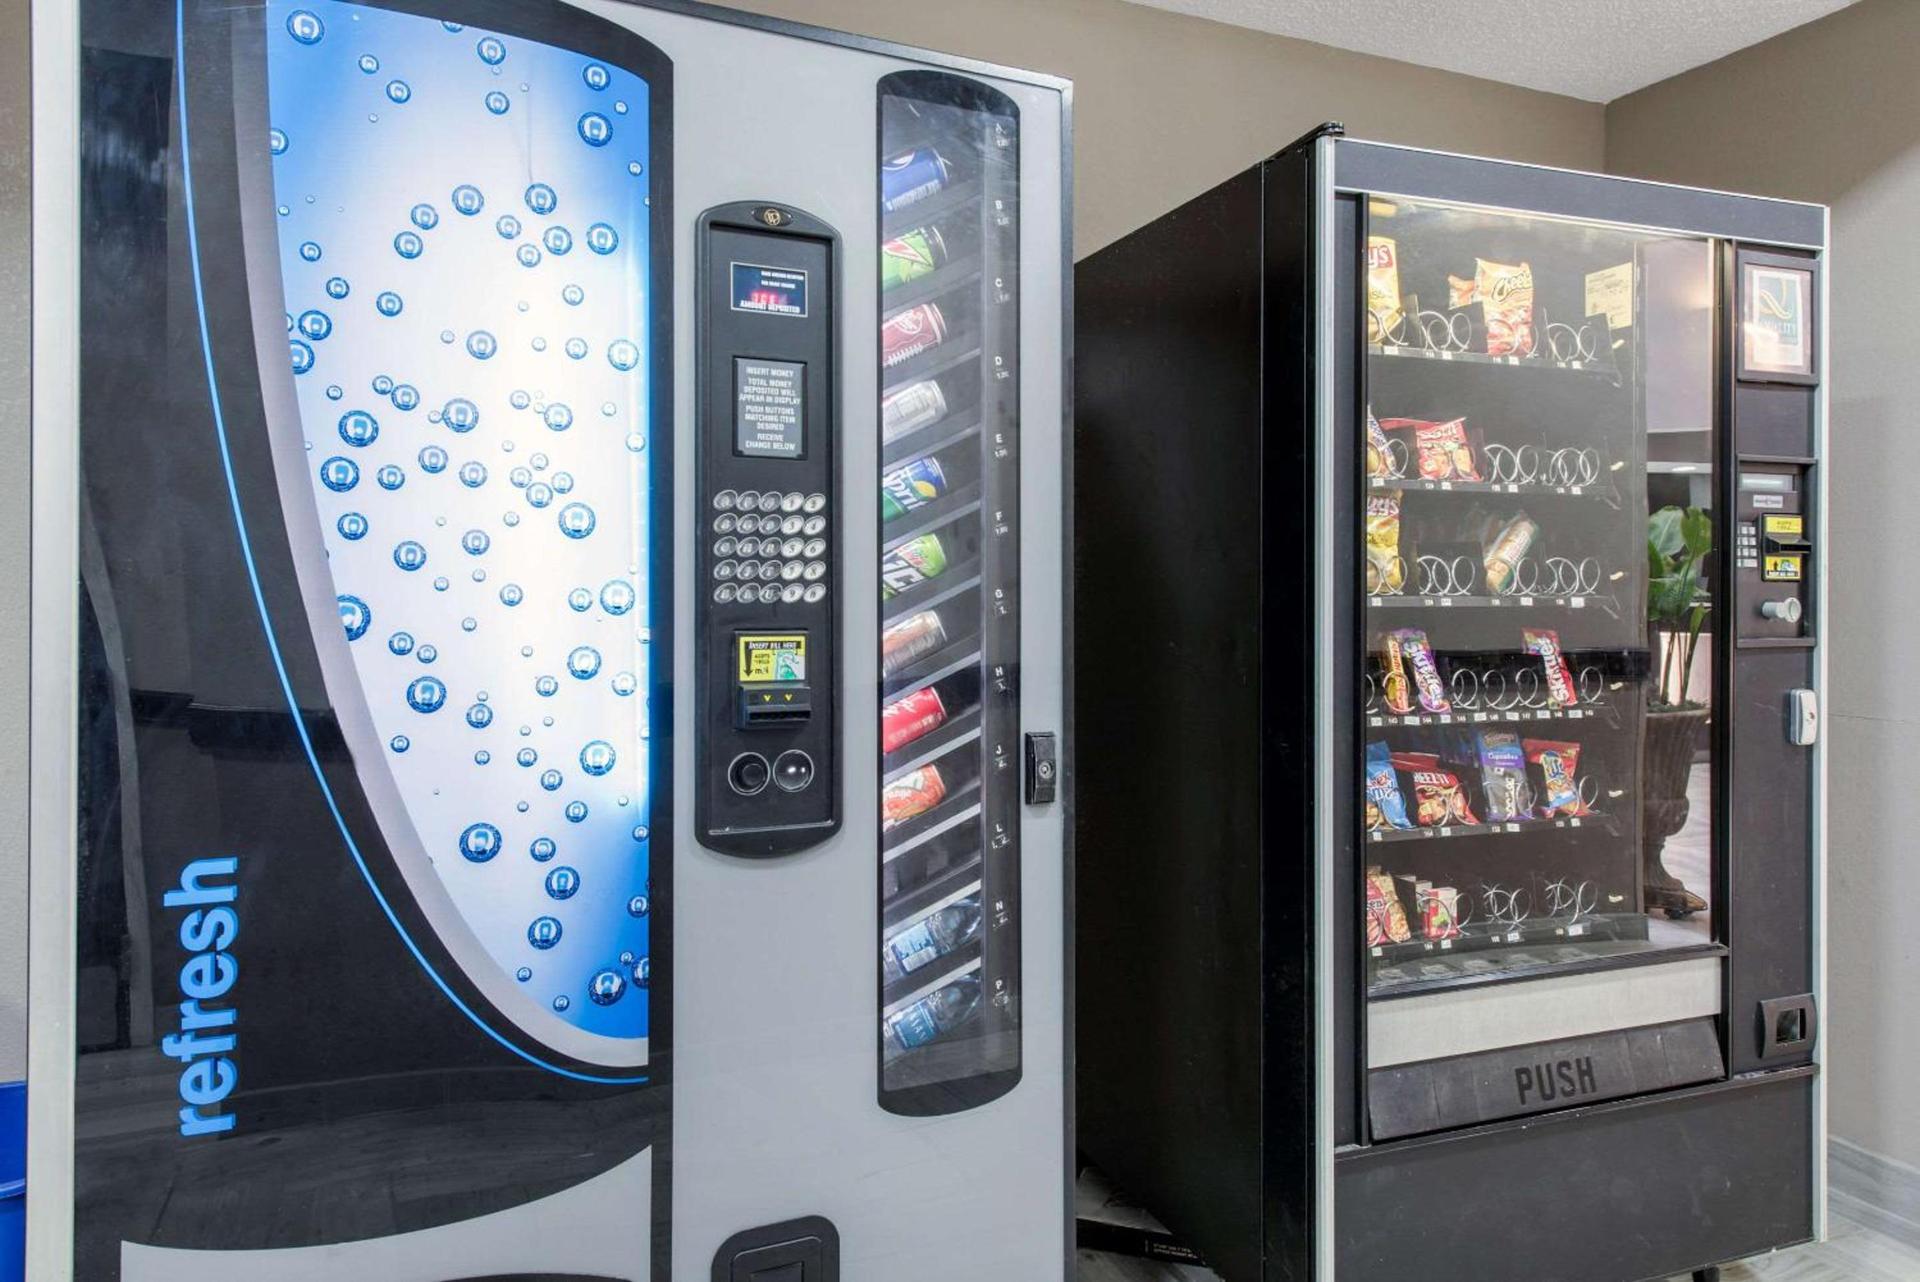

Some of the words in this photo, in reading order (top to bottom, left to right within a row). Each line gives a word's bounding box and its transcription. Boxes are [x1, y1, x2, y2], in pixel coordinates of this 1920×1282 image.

[746, 367, 769, 376] INSERT
[770, 368, 794, 377] MONEY
[748, 378, 768, 386] TOTAL
[769, 380, 791, 388] MONEY
[744, 386, 779, 395] DEPOSITED
[780, 389, 796, 397] WILL
[774, 397, 800, 405] DISPLAY
[746, 405, 763, 413] PUSH
[765, 406, 795, 415] BUTTONS
[780, 416, 796, 424] ITEM
[757, 433, 784, 441] RECEIVE
[745, 440, 770, 449] CHANGE
[772, 442, 796, 450] BELOW
[162, 856, 239, 1137] refresh
[1514, 1056, 1597, 1106] PUSH
